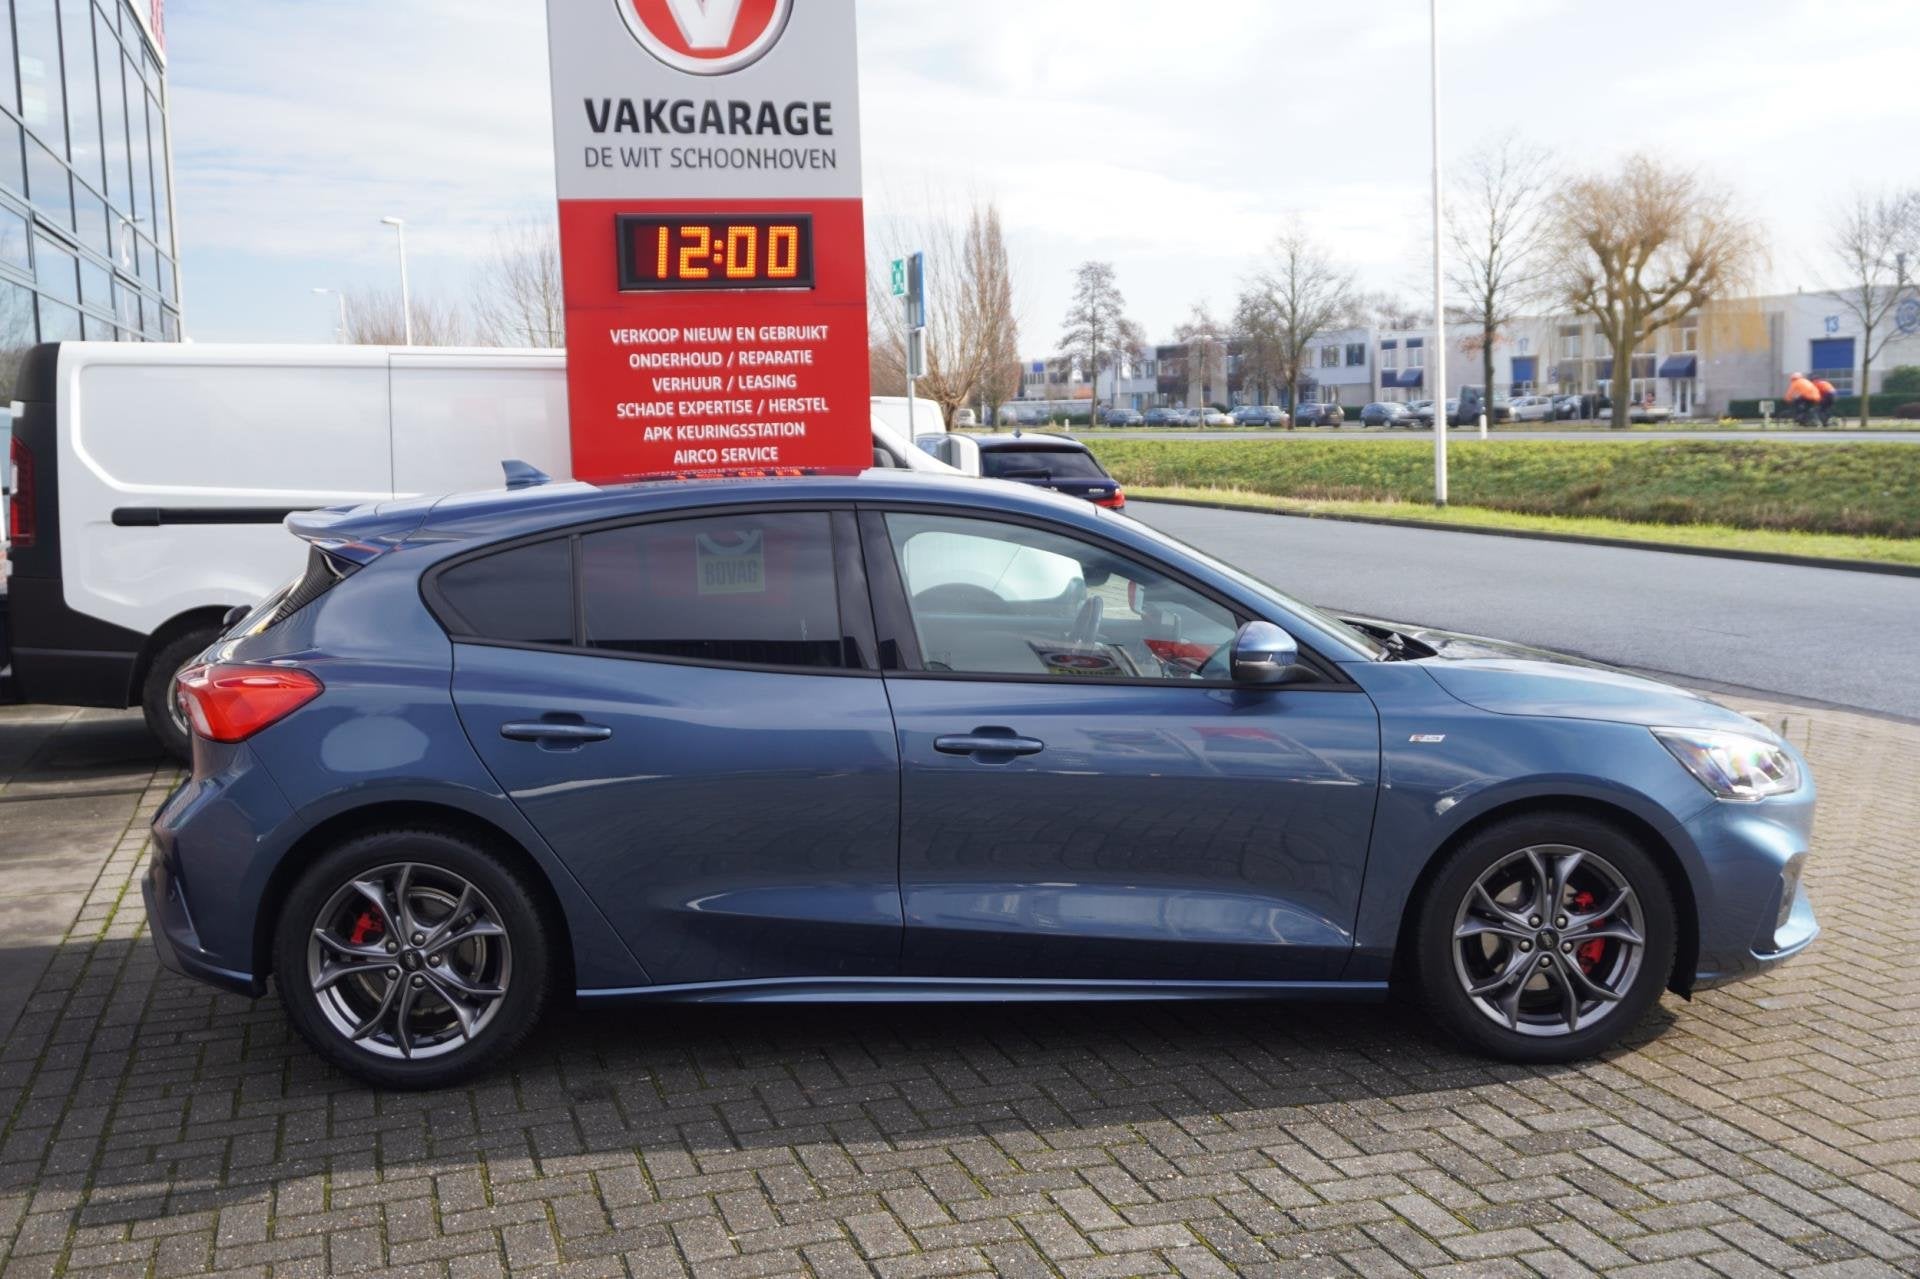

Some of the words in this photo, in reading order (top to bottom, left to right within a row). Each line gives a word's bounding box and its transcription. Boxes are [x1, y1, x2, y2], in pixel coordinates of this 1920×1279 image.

[583, 98, 833, 136] VAKGARAGE
[585, 147, 613, 168] DE
[620, 147, 662, 168] WIT
[670, 148, 837, 169] SCHOONHOVEN
[657, 226, 798, 279] 12:00
[610, 329, 679, 344] VERKOOP
[684, 327, 732, 342] NIEUW
[737, 327, 755, 341] EN
[759, 325, 828, 341] GEBRUIKT
[629, 353, 722, 368] ONDERHOUD
[727, 352, 734, 367] /
[739, 350, 812, 365] REPARATIE
[652, 376, 722, 392] VERHUUR
[727, 376, 734, 391] /
[738, 374, 797, 390] LEASING
[617, 402, 674, 418] SCHADE
[679, 400, 753, 416] EXPERTISE
[757, 399, 764, 414] /
[769, 397, 829, 412] HERSTEL
[643, 426, 672, 441] APK
[677, 422, 805, 440] KEURINGSSTATION
[673, 449, 718, 465] AIRCO
[721, 447, 778, 462] SERVICE
[705, 560, 758, 586] BOVAG
